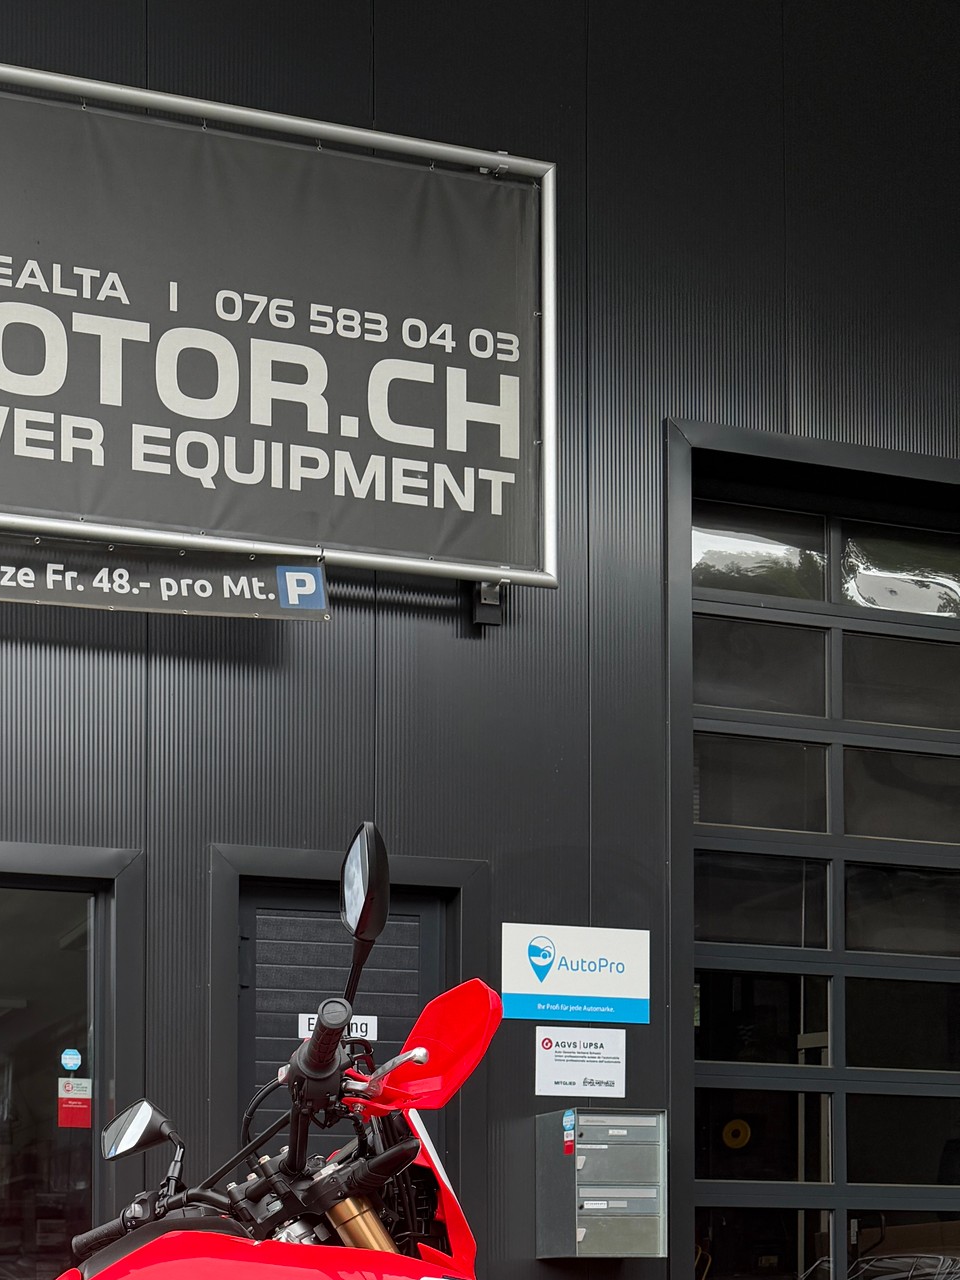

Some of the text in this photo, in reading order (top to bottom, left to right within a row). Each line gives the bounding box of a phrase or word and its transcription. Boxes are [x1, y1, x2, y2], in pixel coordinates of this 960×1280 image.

[215, 289, 294, 329] 076
[309, 304, 388, 342] 583
[402, 318, 456, 352] 04
[468, 328, 520, 362] 03
[131, 423, 515, 516] EQUIPMENT
[46, 563, 85, 592] Fr.
[92, 567, 150, 594] 48.-
[160, 574, 213, 601] pro
[222, 575, 276, 600] Mt.
[557, 955, 626, 975] AutoPro
[569, 1004, 582, 1012] jede
[554, 1041, 605, 1050] AGVS UPSA
